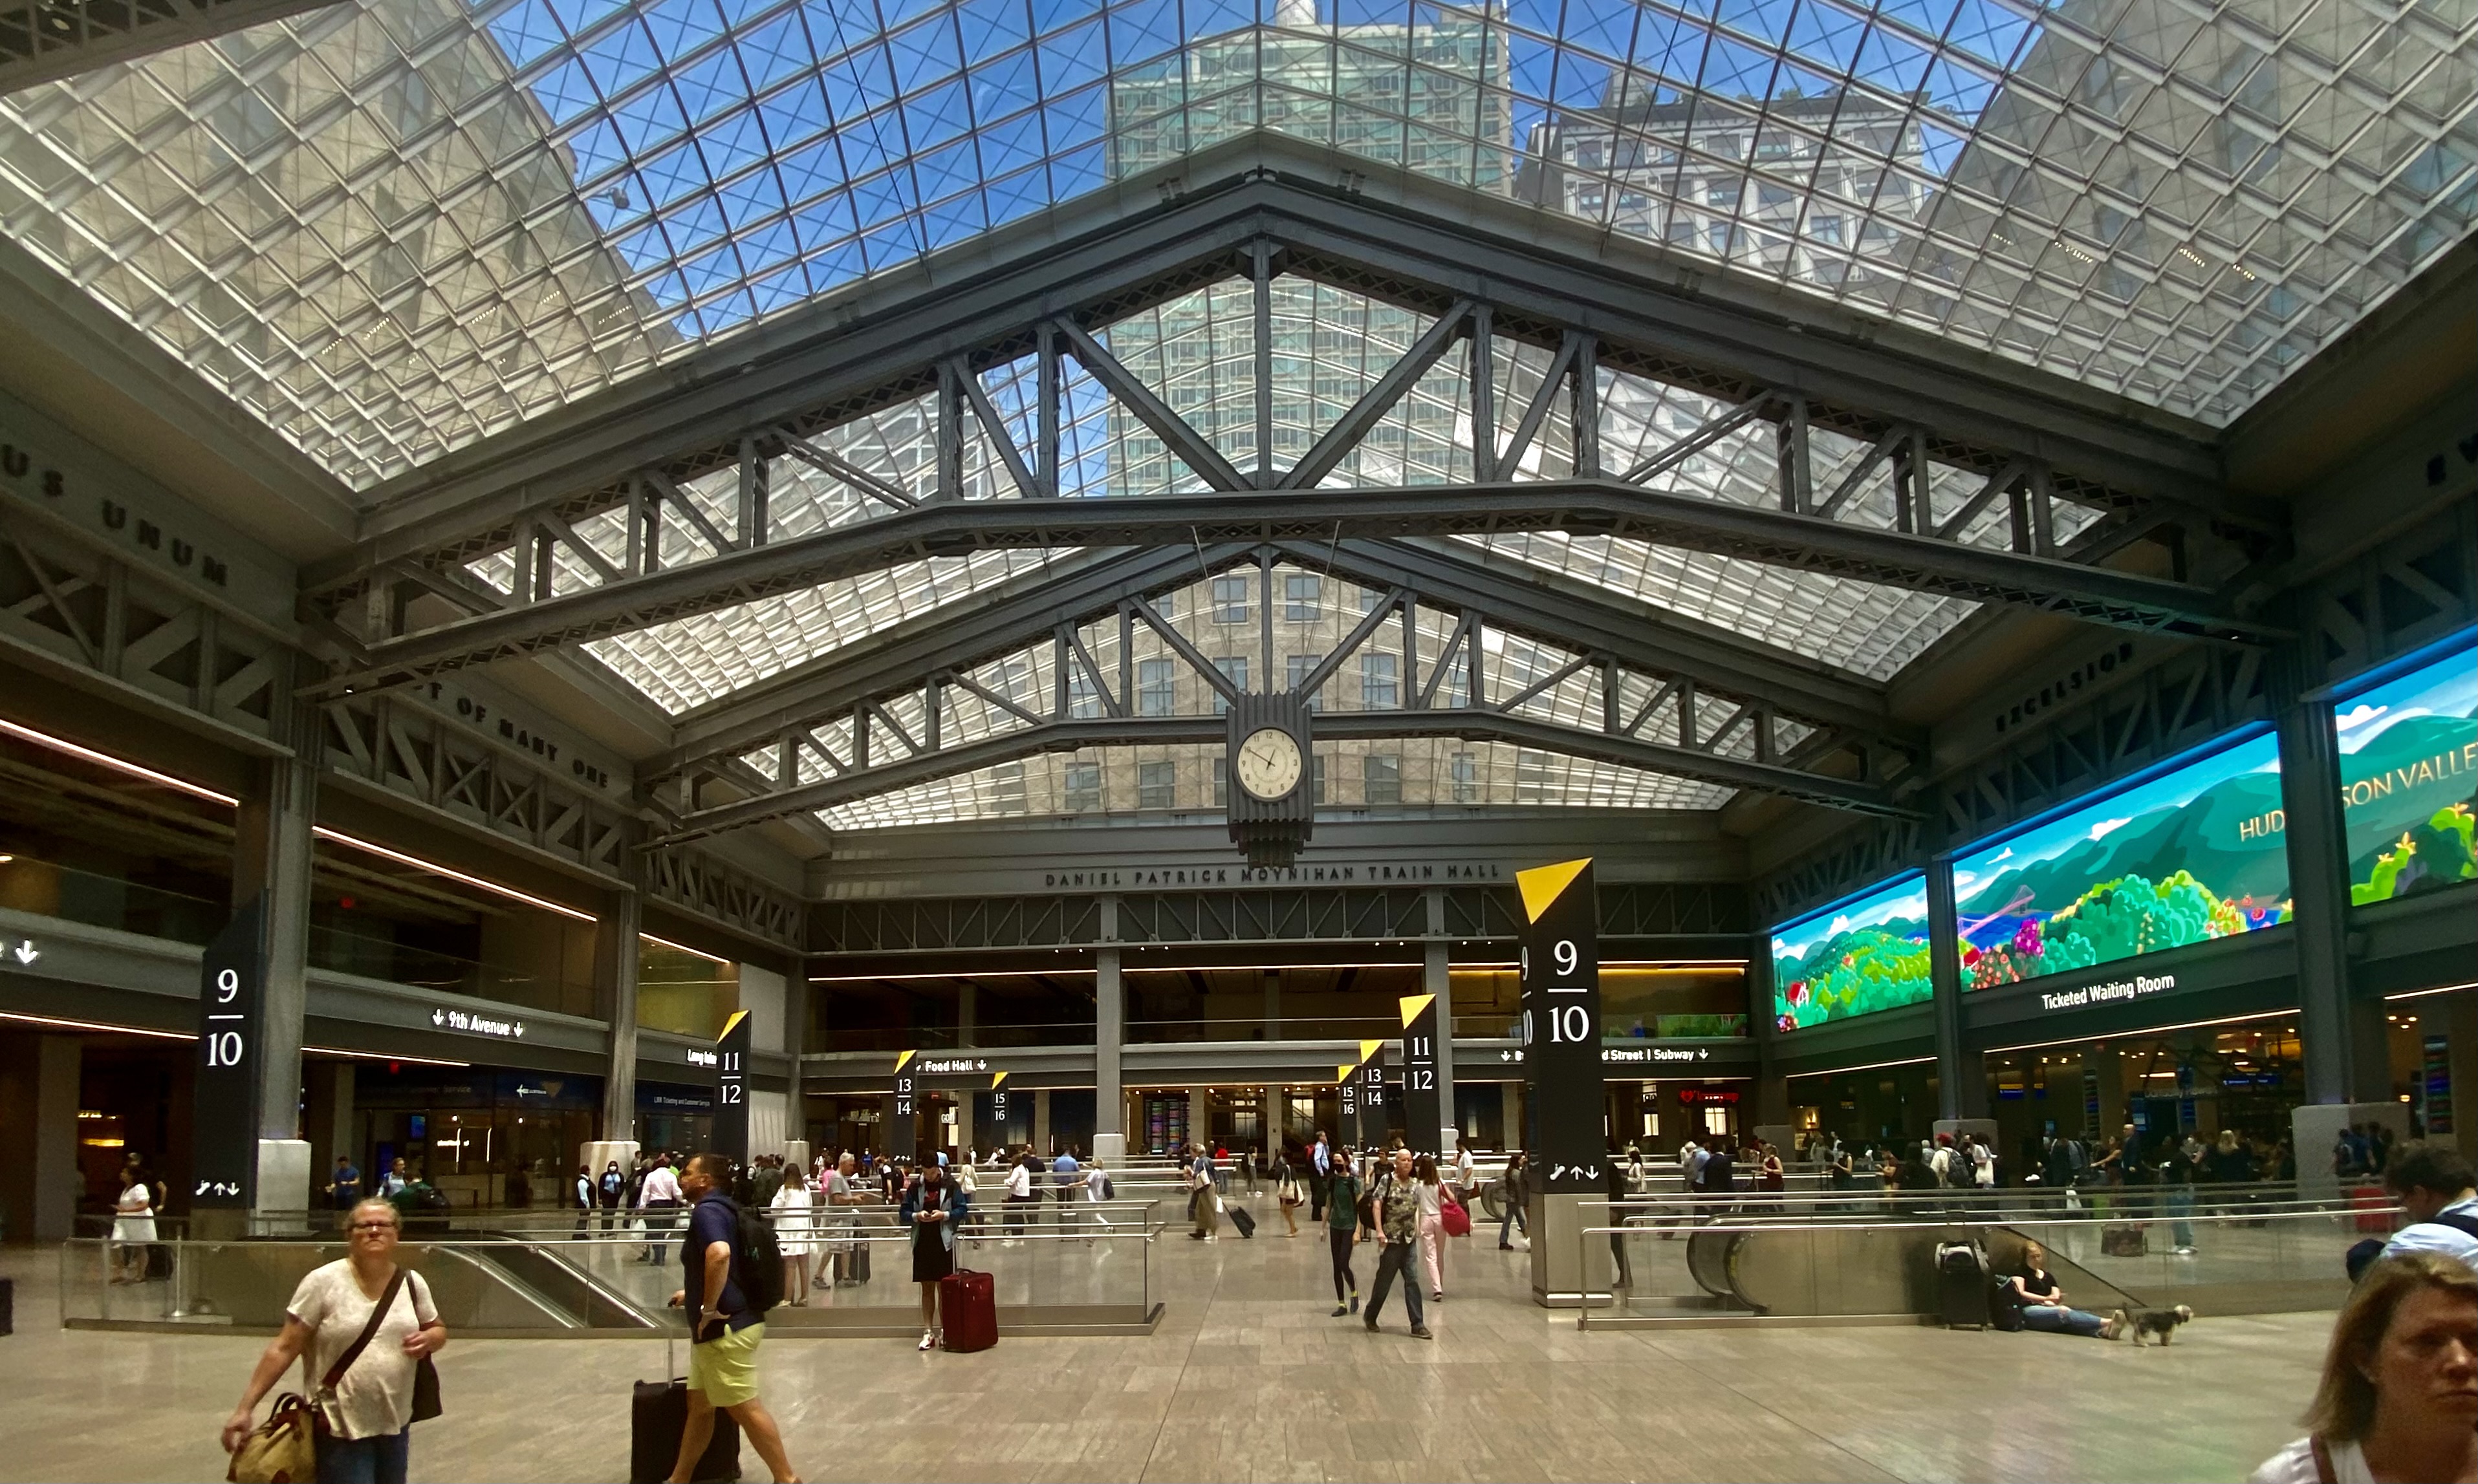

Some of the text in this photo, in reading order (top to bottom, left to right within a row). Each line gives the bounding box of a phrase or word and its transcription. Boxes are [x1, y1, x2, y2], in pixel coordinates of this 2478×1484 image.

[102, 499, 227, 586] UNUM
[457, 697, 486, 722] OF
[499, 718, 558, 762] MANY
[2397, 742, 2478, 790] VALLE
[1045, 864, 1499, 887] DANIEL PATRICK MOYNIHAN TRAIN HALL
[1521, 946, 1528, 981] 9
[1554, 940, 1578, 976] 9
[217, 969, 239, 1004] 9
[2041, 974, 2175, 1010] Ticketed Waiting Room
[448, 1011, 510, 1036] 9th Avenue
[1523, 1009, 1533, 1046] 10
[1548, 1005, 1590, 1042] 10
[207, 1031, 243, 1066] 10
[1413, 1037, 1430, 1056] 11
[1611, 1049, 1644, 1060] Street
[1653, 1049, 1695, 1061] Subway
[687, 1048, 704, 1066] Long
[724, 1052, 739, 1071] 11
[925, 1059, 973, 1072] Food Hall
[898, 1078, 911, 1091] 13
[1368, 1068, 1382, 1082] 13
[1413, 1070, 1433, 1090] 12
[721, 1084, 741, 1104] 12
[995, 1093, 1005, 1103] 15
[1343, 1086, 1354, 1097] 15
[1368, 1091, 1383, 1106] 14
[897, 1101, 911, 1115] 14
[995, 1110, 1006, 1121] 16
[1343, 1103, 1354, 1115] 16
